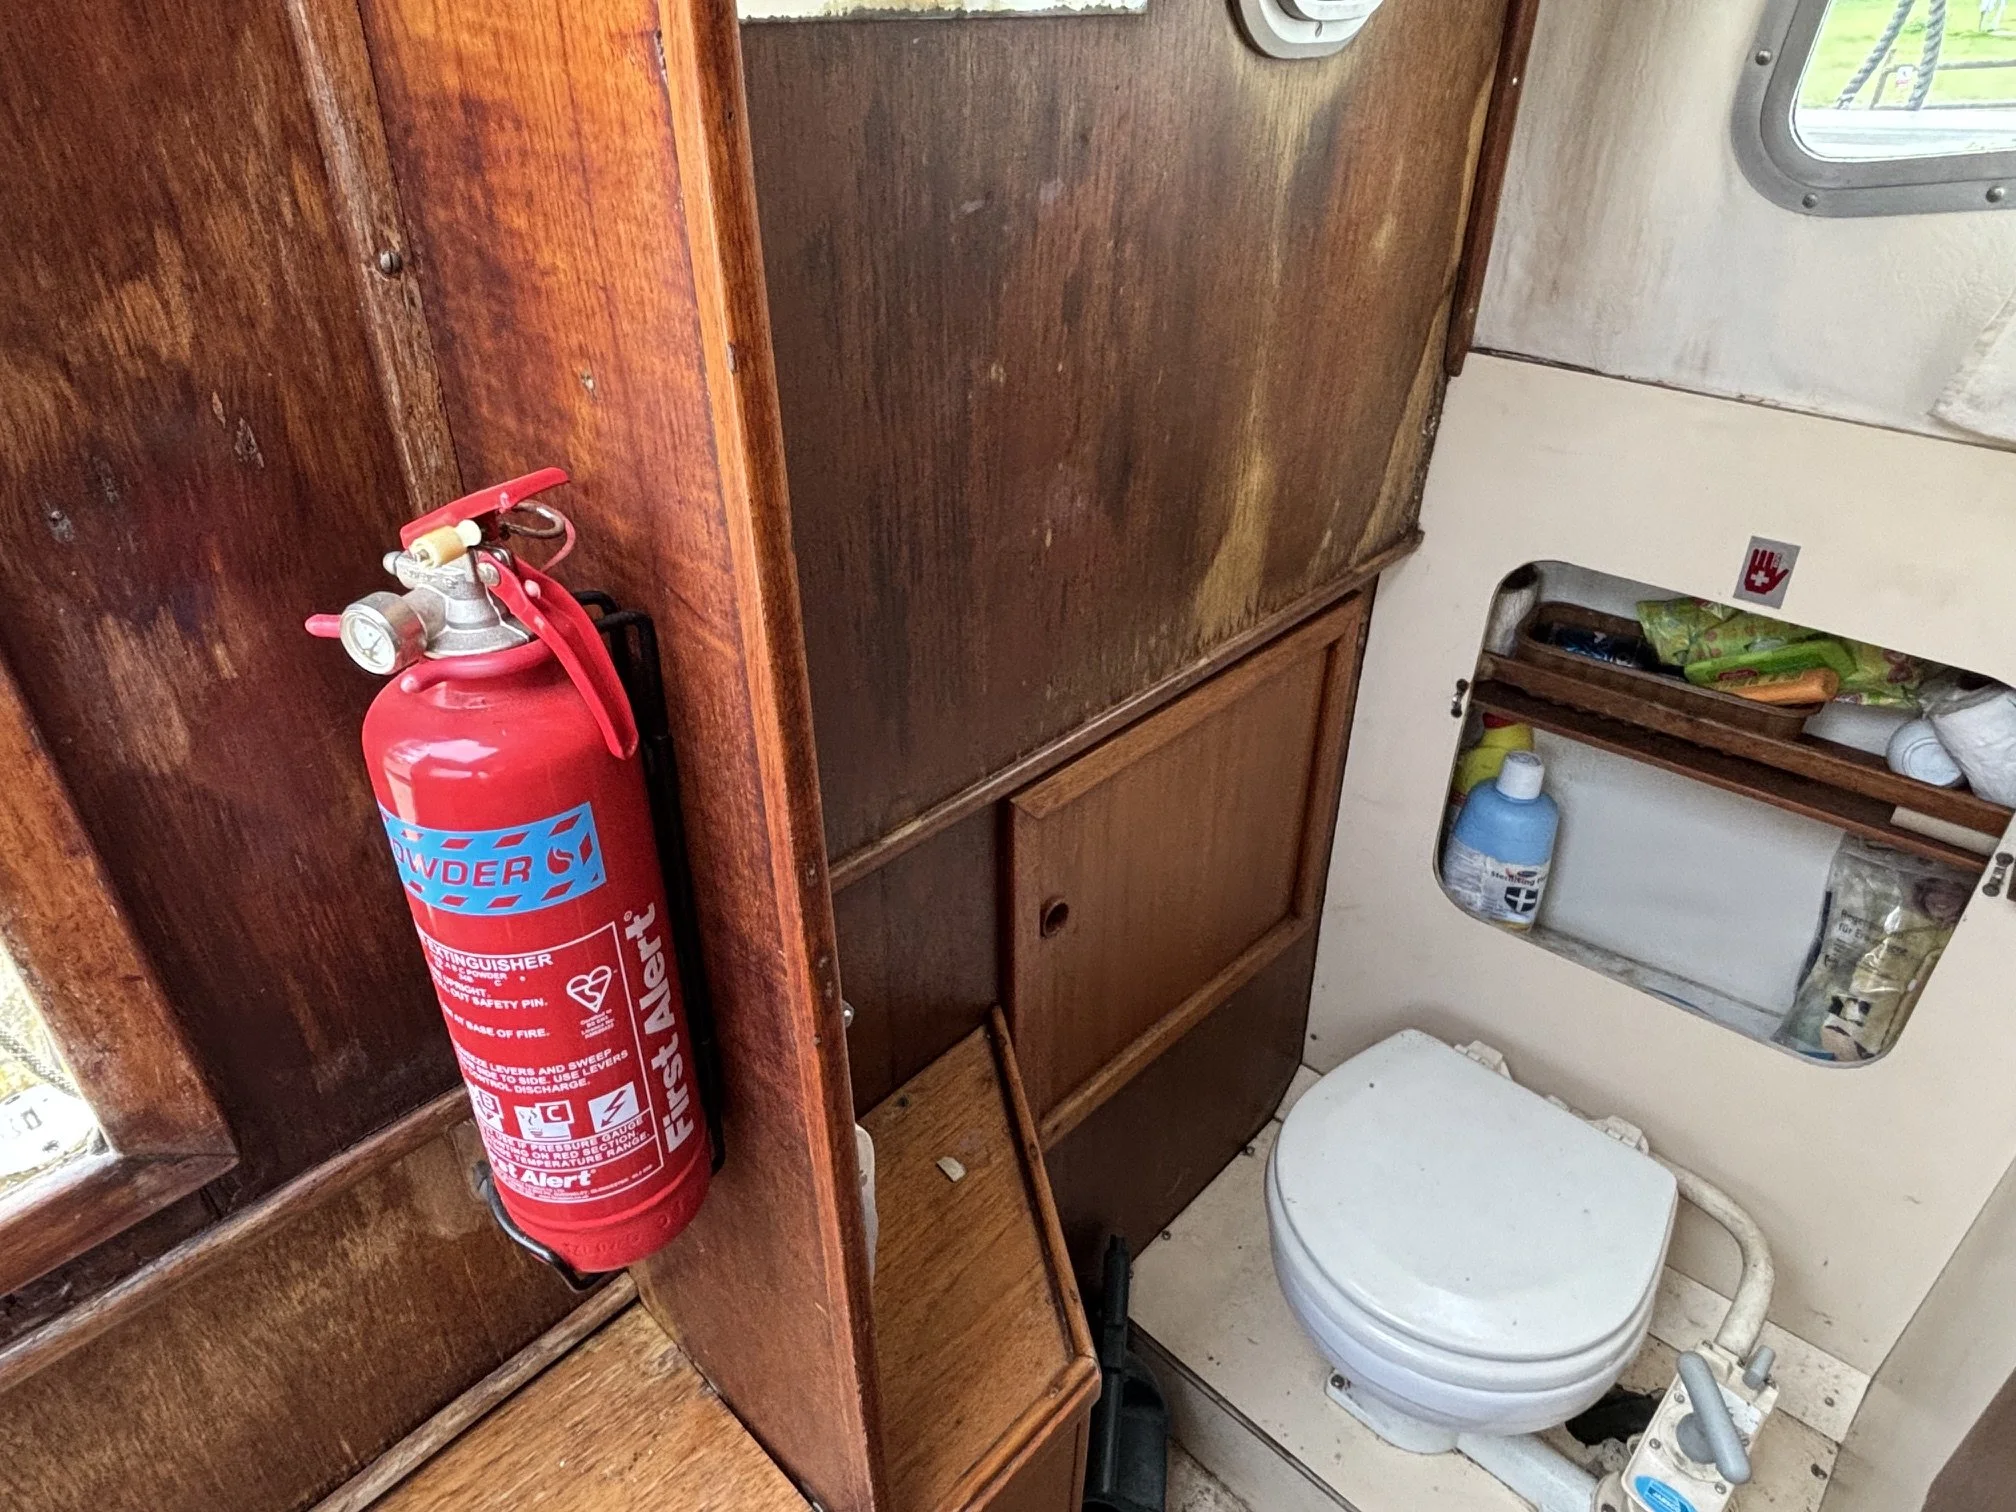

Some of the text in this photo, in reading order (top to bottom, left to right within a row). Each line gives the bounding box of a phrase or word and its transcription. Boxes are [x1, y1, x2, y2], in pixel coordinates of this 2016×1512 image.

[426, 938, 554, 972] EXTINGUISHER
[472, 996, 519, 1010] SAFETY
[521, 997, 549, 1009] PIN.
[496, 1028, 514, 1039] OF
[516, 1028, 550, 1039] FIRE.
[625, 901, 695, 1153] First Alert
[490, 1048, 612, 1076] LEVERS AND SWEEP
[501, 1073, 516, 1083] TO
[553, 1069, 580, 1083] USE
[582, 1049, 629, 1077] LEVERS
[514, 1077, 591, 1095] DISCHARGE.
[547, 1105, 563, 1121] C
[530, 1137, 598, 1153] PRESSURE
[601, 1115, 644, 1143] GAUGE
[514, 1131, 651, 1168] TEMPERATURE RANGE.
[531, 1150, 550, 1160] ON
[553, 1149, 580, 1160] RED
[520, 1168, 592, 1189] Alert
